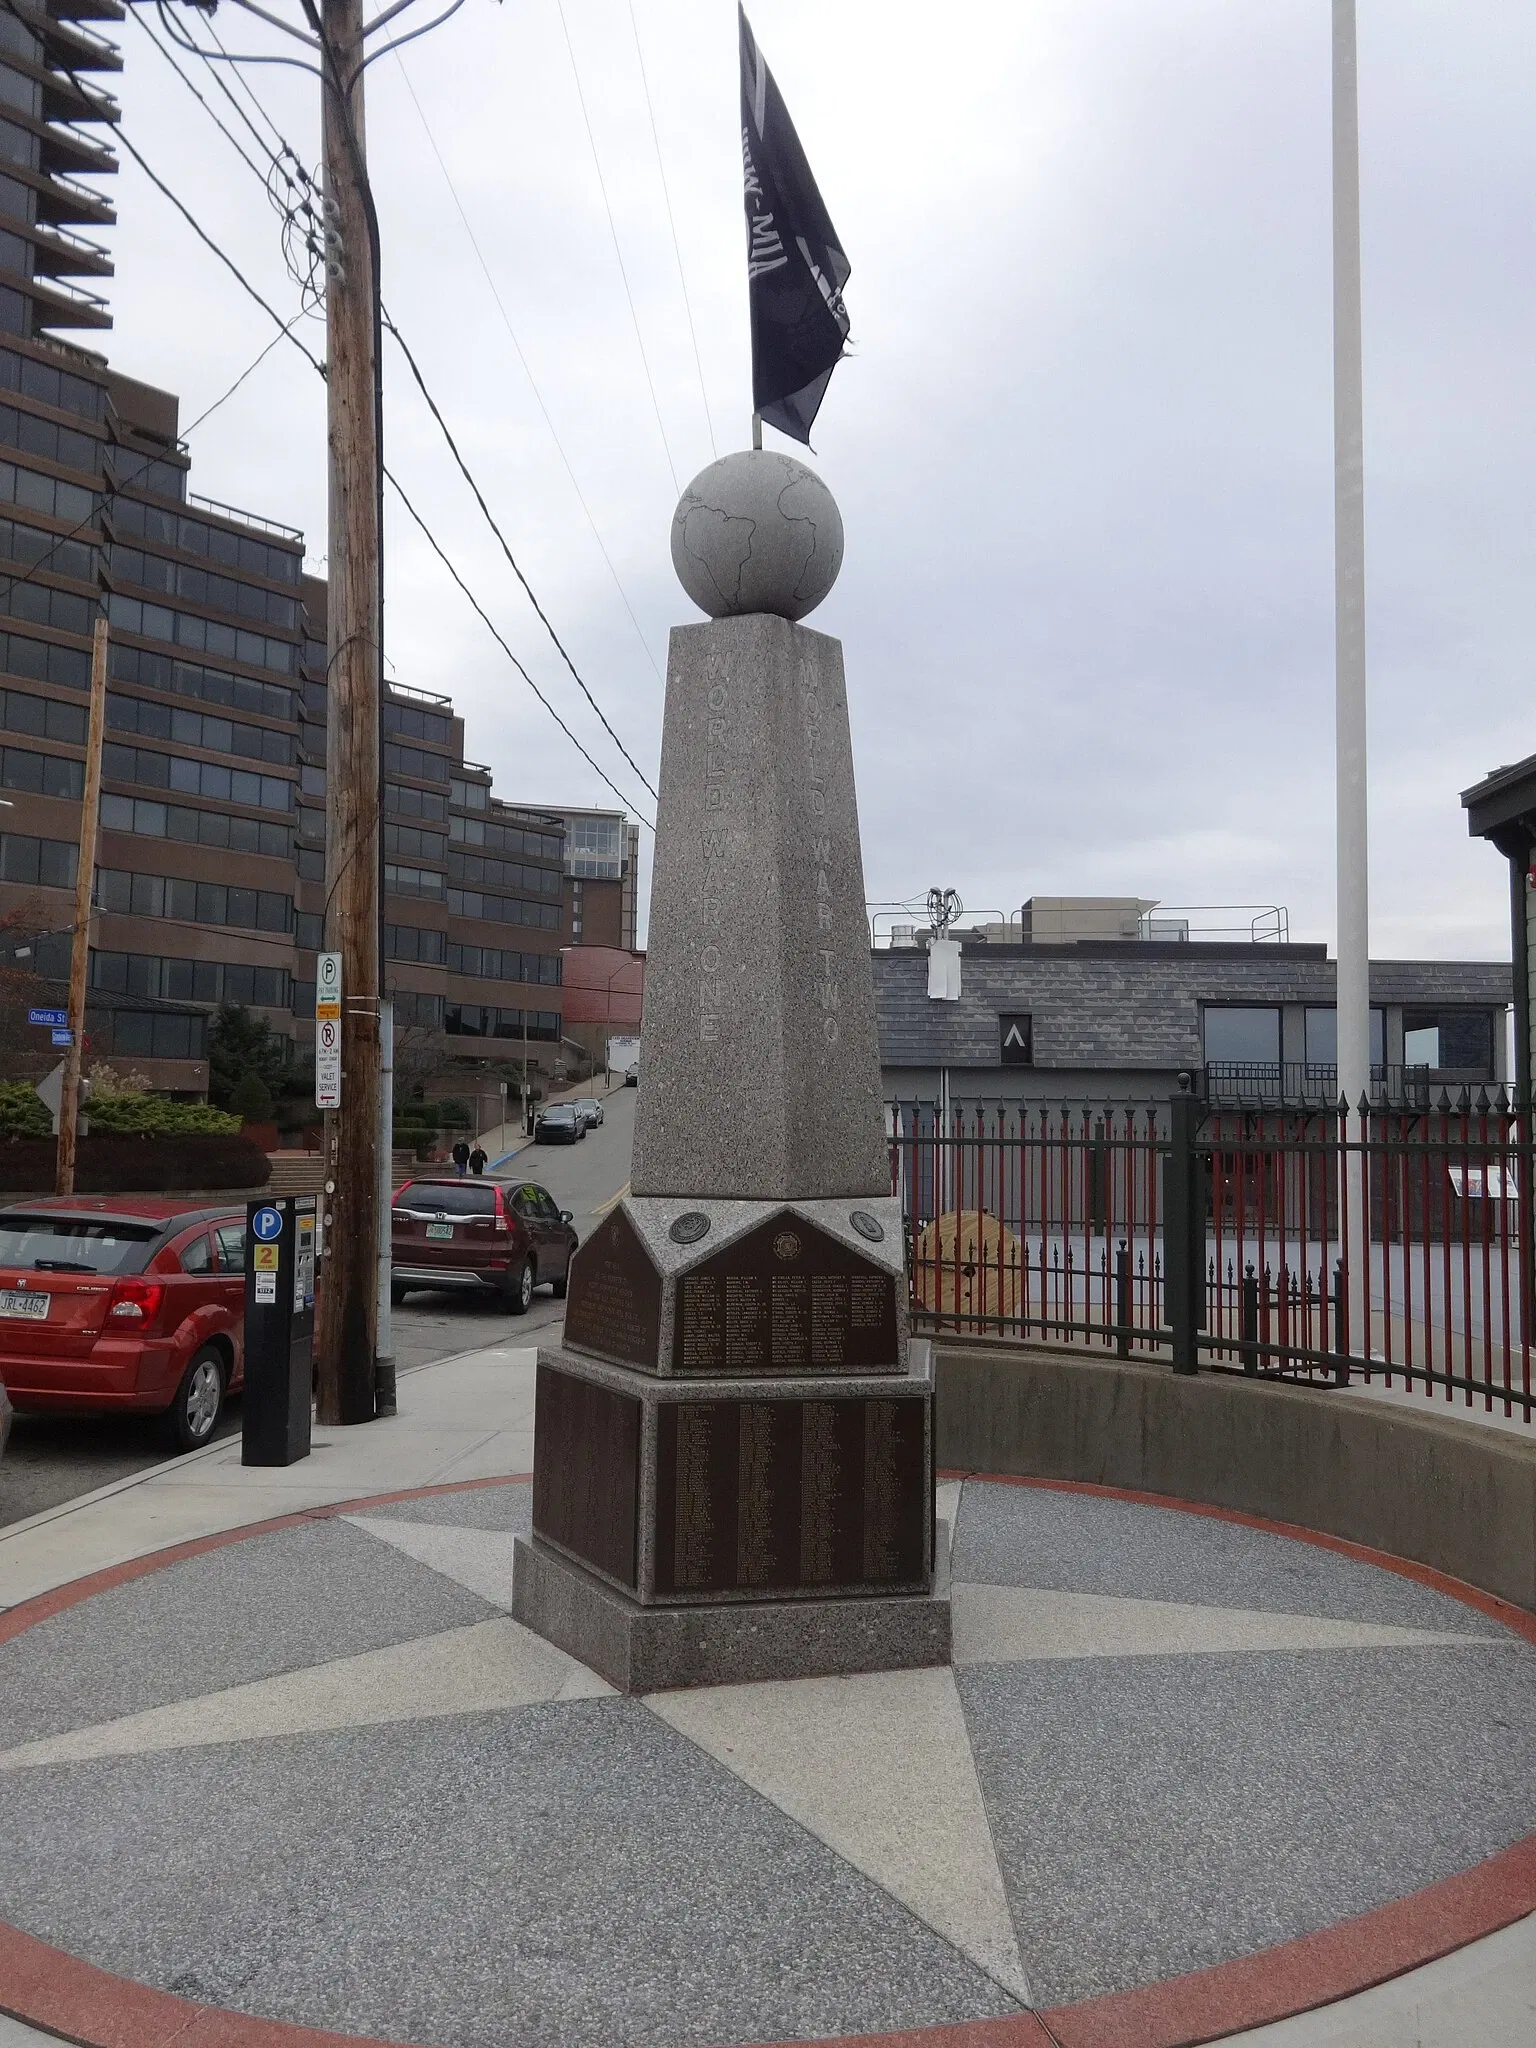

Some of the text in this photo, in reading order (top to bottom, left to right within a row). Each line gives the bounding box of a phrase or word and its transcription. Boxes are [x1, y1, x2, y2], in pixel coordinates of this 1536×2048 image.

[748, 211, 788, 280] MIA
[698, 651, 732, 1043] WORLD WAR ONE
[813, 836, 835, 931] WAR
[818, 948, 841, 1043] TWO
[30, 1011, 66, 1023] Oneida St
[318, 1083, 337, 1092] SERVICE
[320, 1072, 335, 1081] VALET
[261, 1213, 275, 1235] P
[260, 1247, 273, 1264] 2
